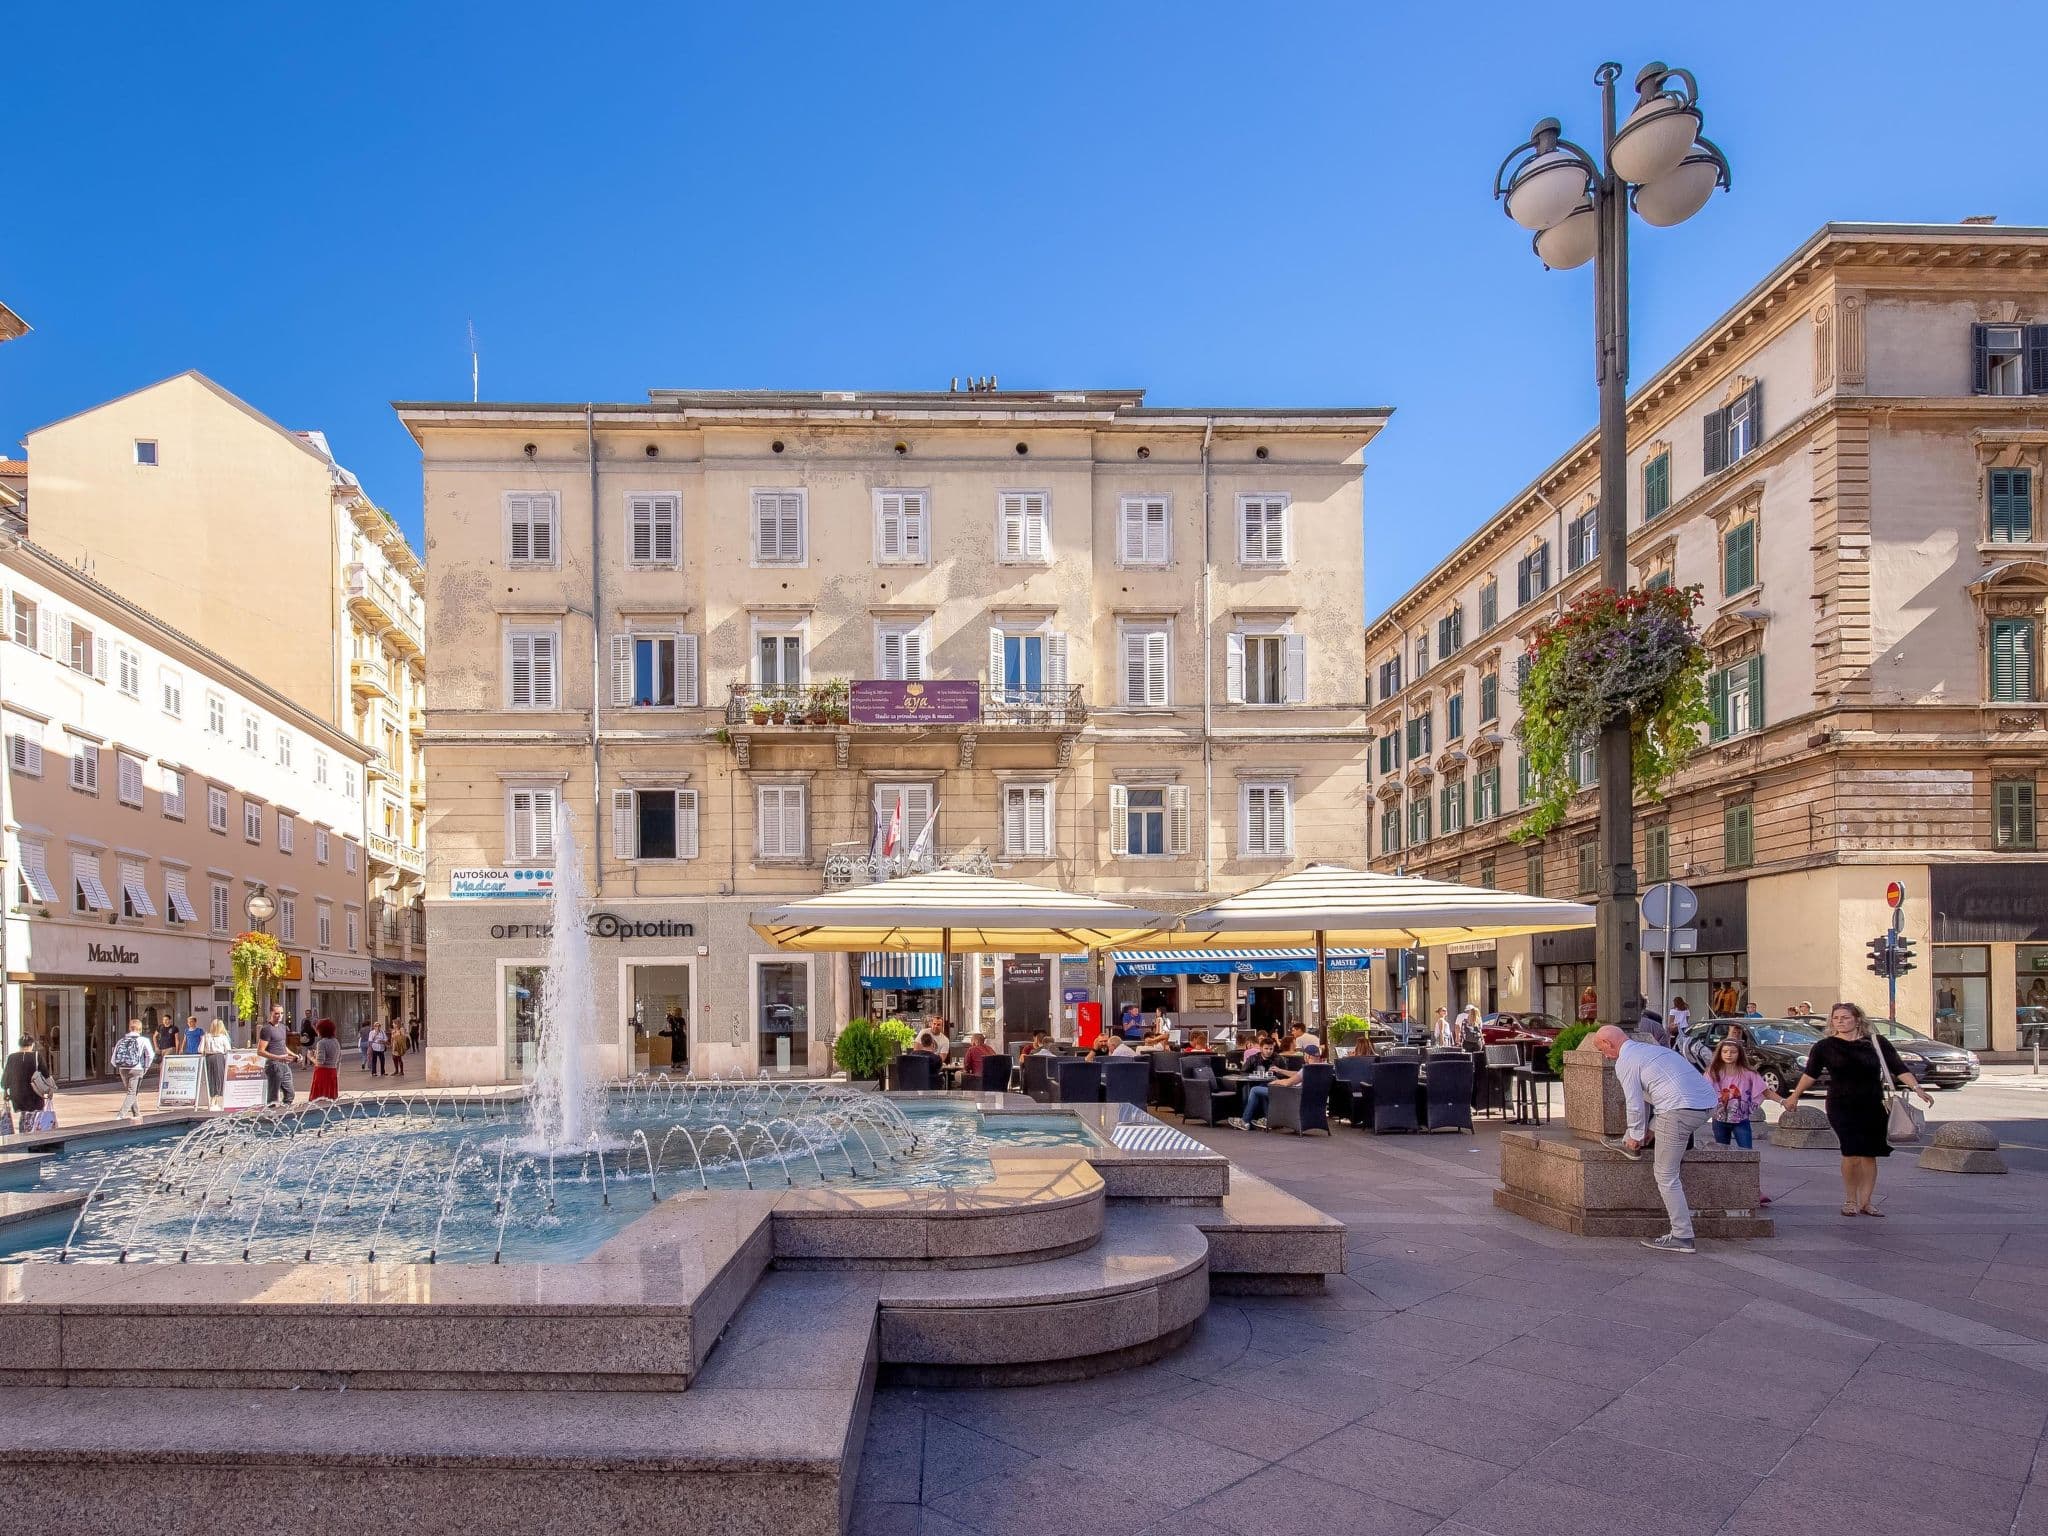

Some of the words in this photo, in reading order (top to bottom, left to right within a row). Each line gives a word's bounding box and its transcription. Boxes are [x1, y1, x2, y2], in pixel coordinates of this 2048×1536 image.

[453, 869, 509, 879] AUTOŠKOLA
[490, 924, 555, 939] OPTIK
[597, 915, 694, 942] Optotim
[88, 942, 139, 964] MaxMara
[1129, 963, 1156, 974] AMSTEL
